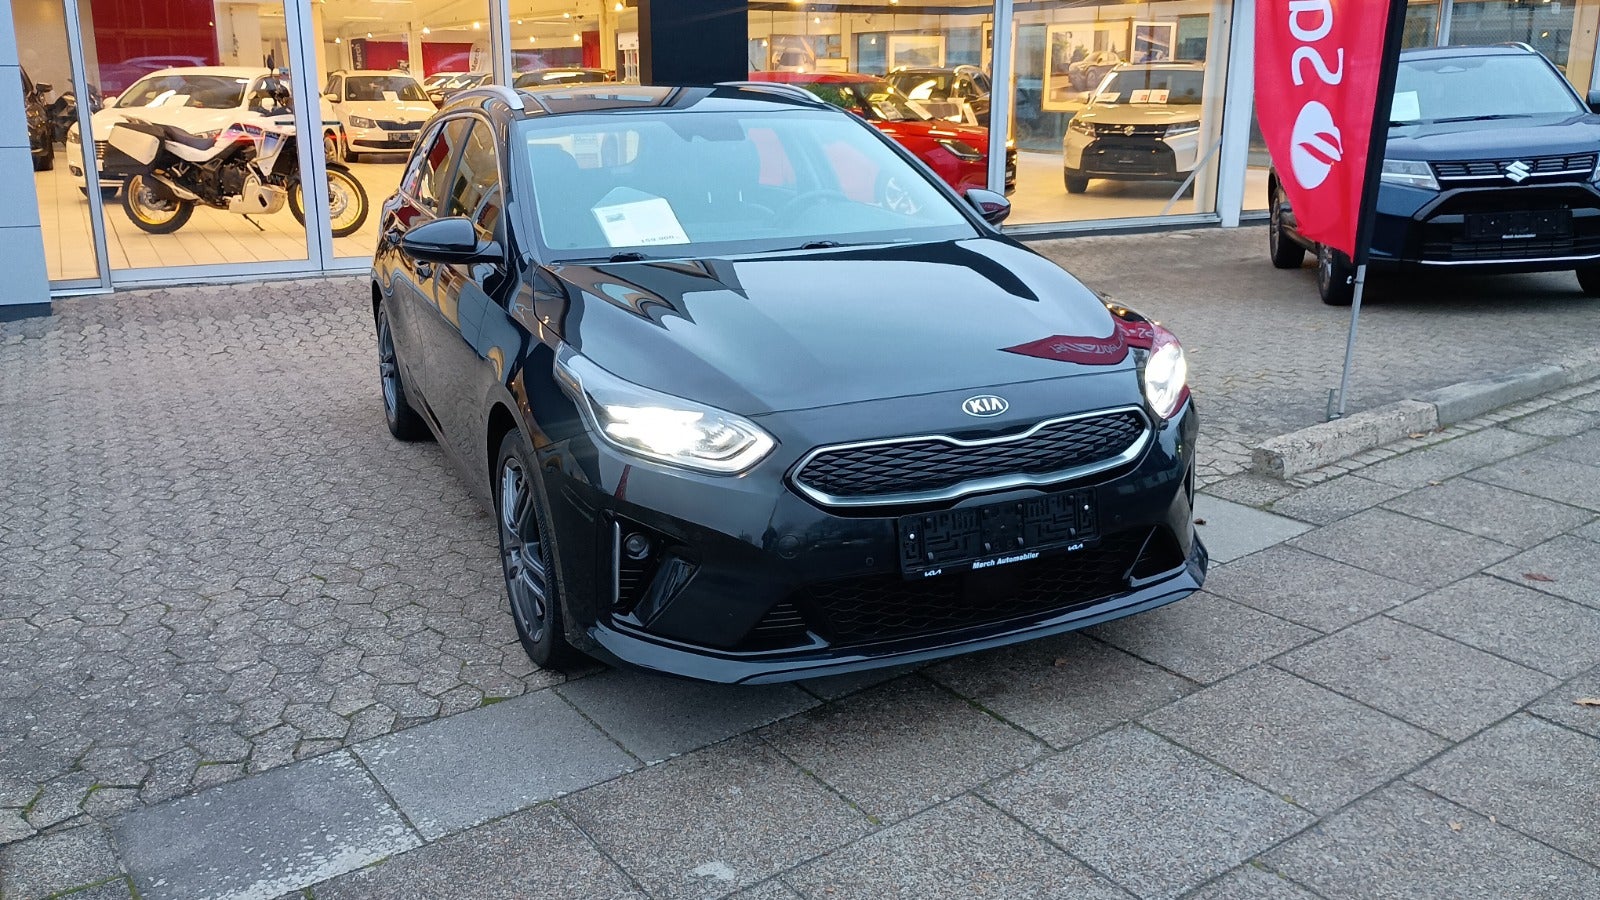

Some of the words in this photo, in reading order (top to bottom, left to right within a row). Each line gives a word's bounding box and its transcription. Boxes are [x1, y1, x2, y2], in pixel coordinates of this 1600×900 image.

[354, 43, 362, 69] March
[969, 397, 1004, 414] KIA
[972, 559, 995, 570] March
